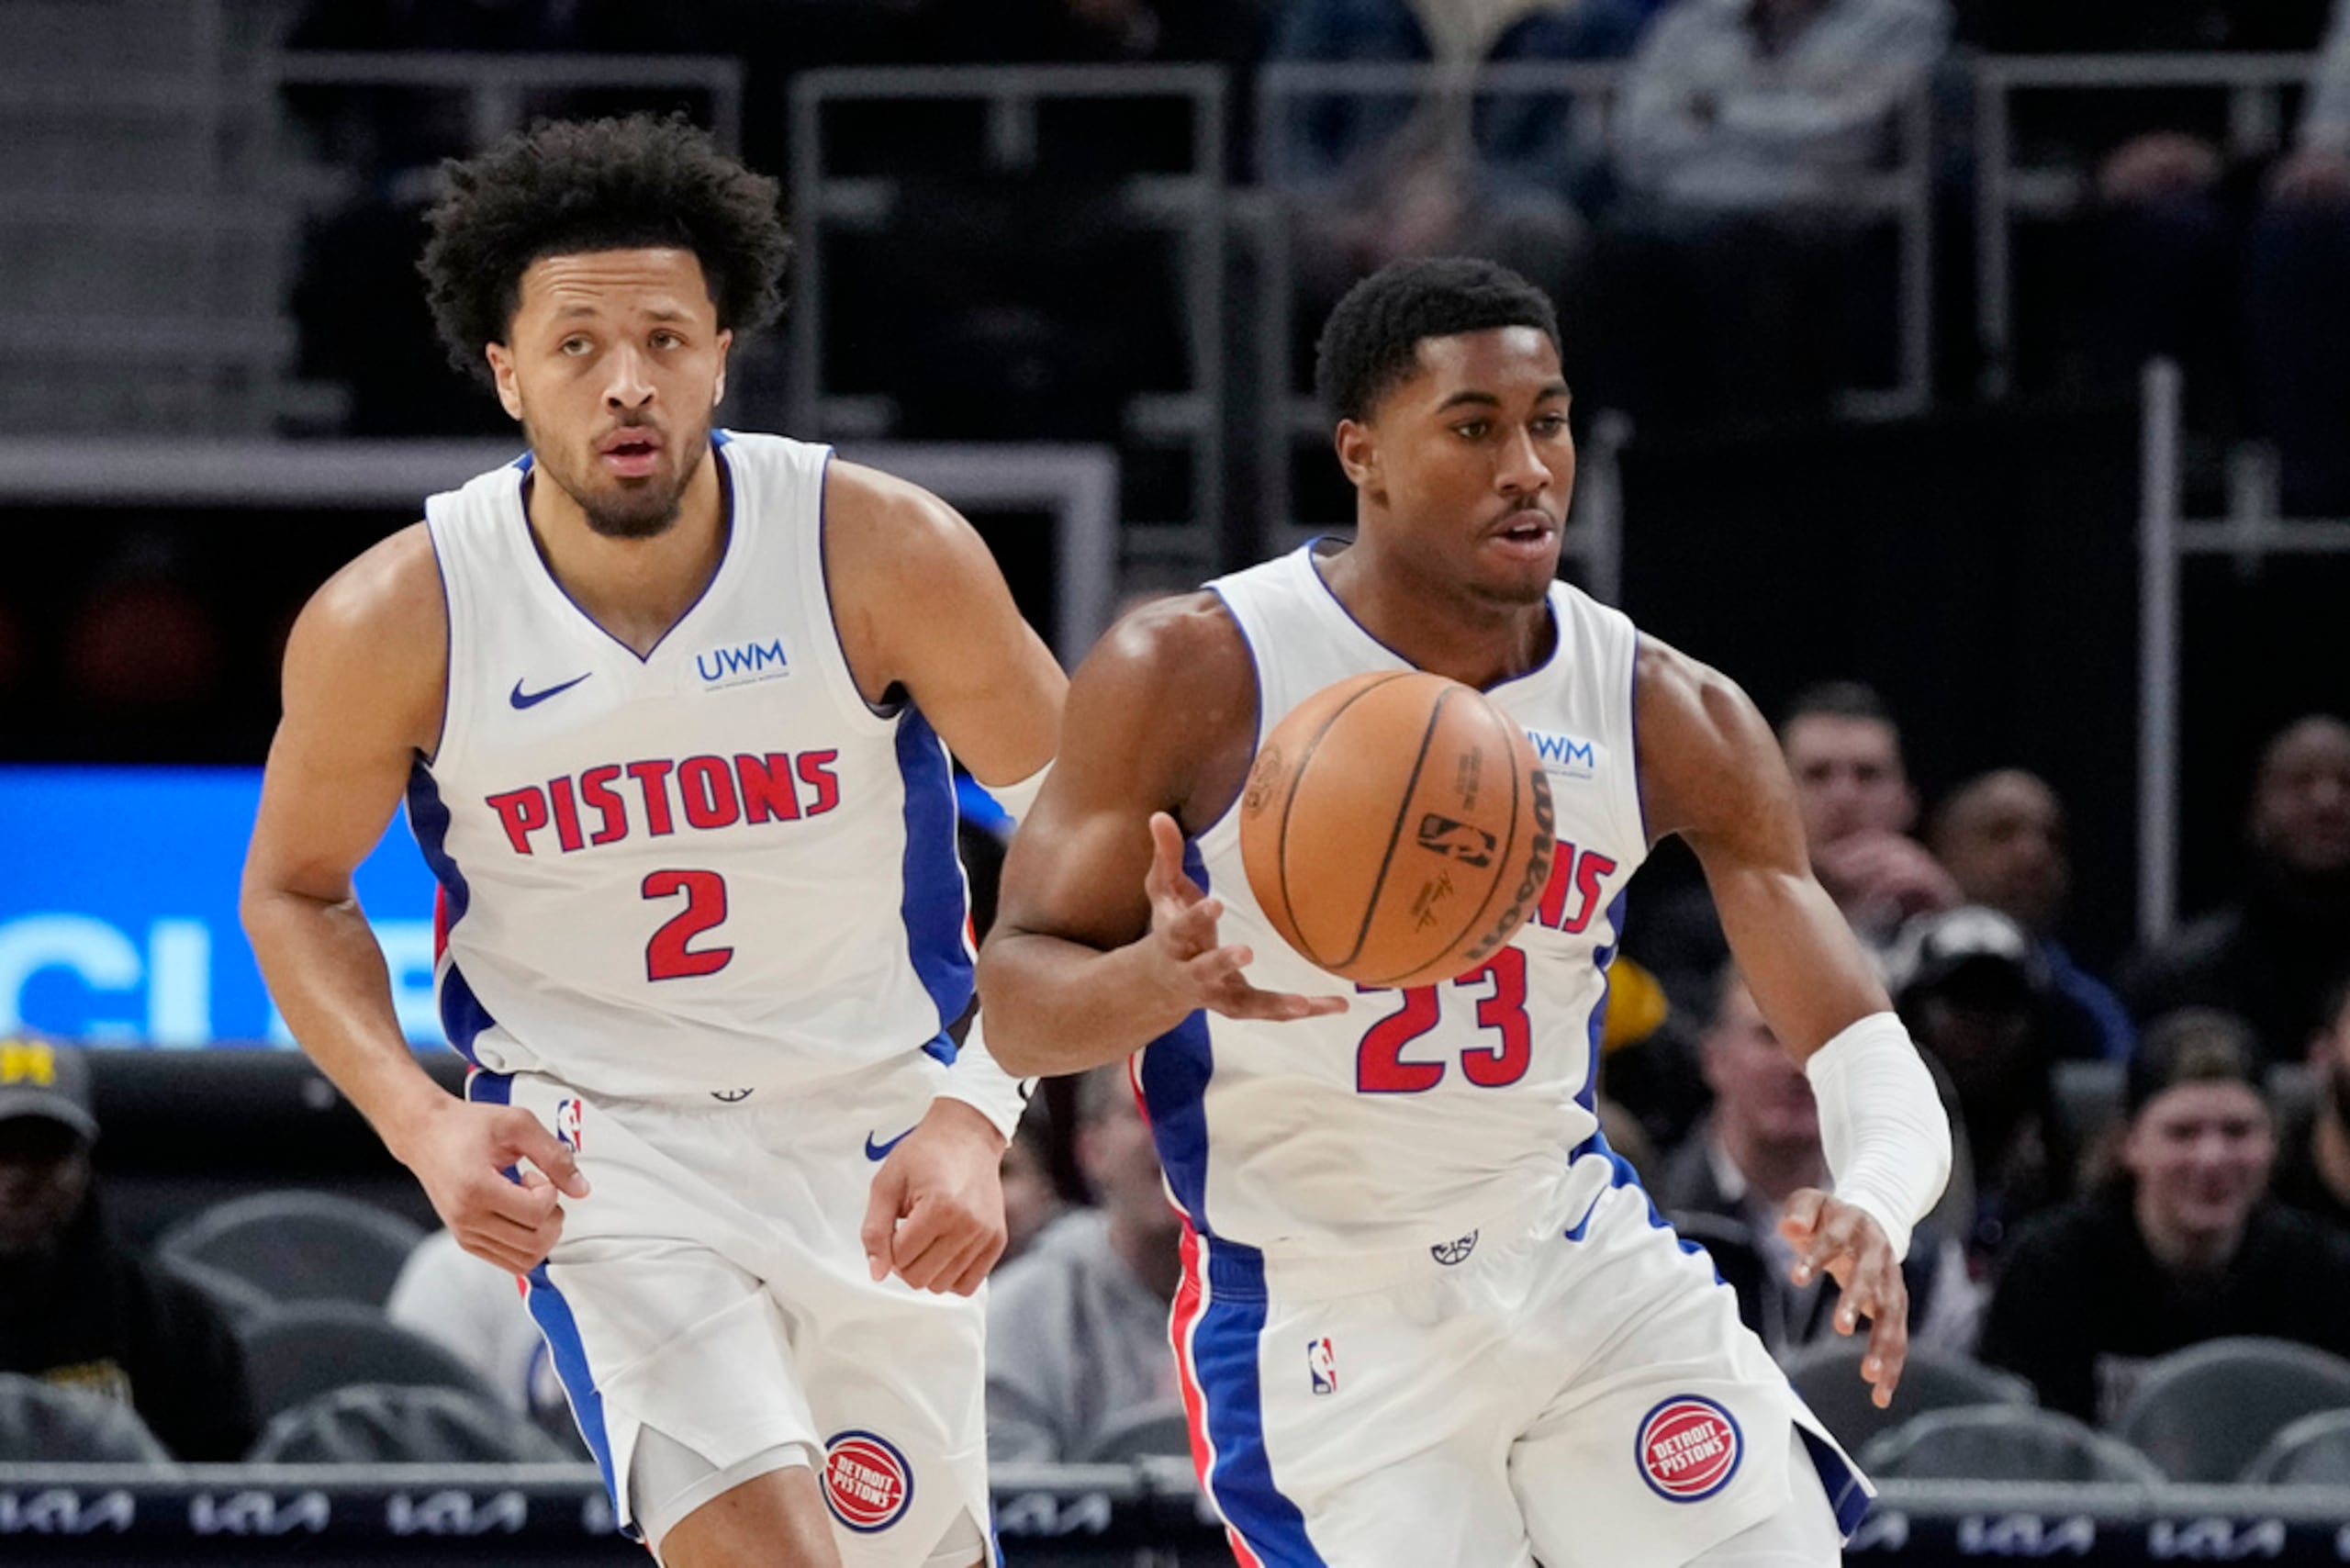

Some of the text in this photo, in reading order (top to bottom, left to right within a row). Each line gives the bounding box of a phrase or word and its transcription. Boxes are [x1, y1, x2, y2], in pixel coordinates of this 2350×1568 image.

[696, 638, 788, 681] UWM
[1528, 731, 1594, 768] WM
[485, 748, 840, 856] PISTONS
[643, 869, 734, 983] 2
[1355, 946, 1531, 1093] 23
[1652, 1419, 1716, 1461] DETROIT
[1659, 1436, 1726, 1477] PISTONS
[832, 1471, 890, 1507] PISTONS
[835, 1455, 896, 1494] DETROIT
